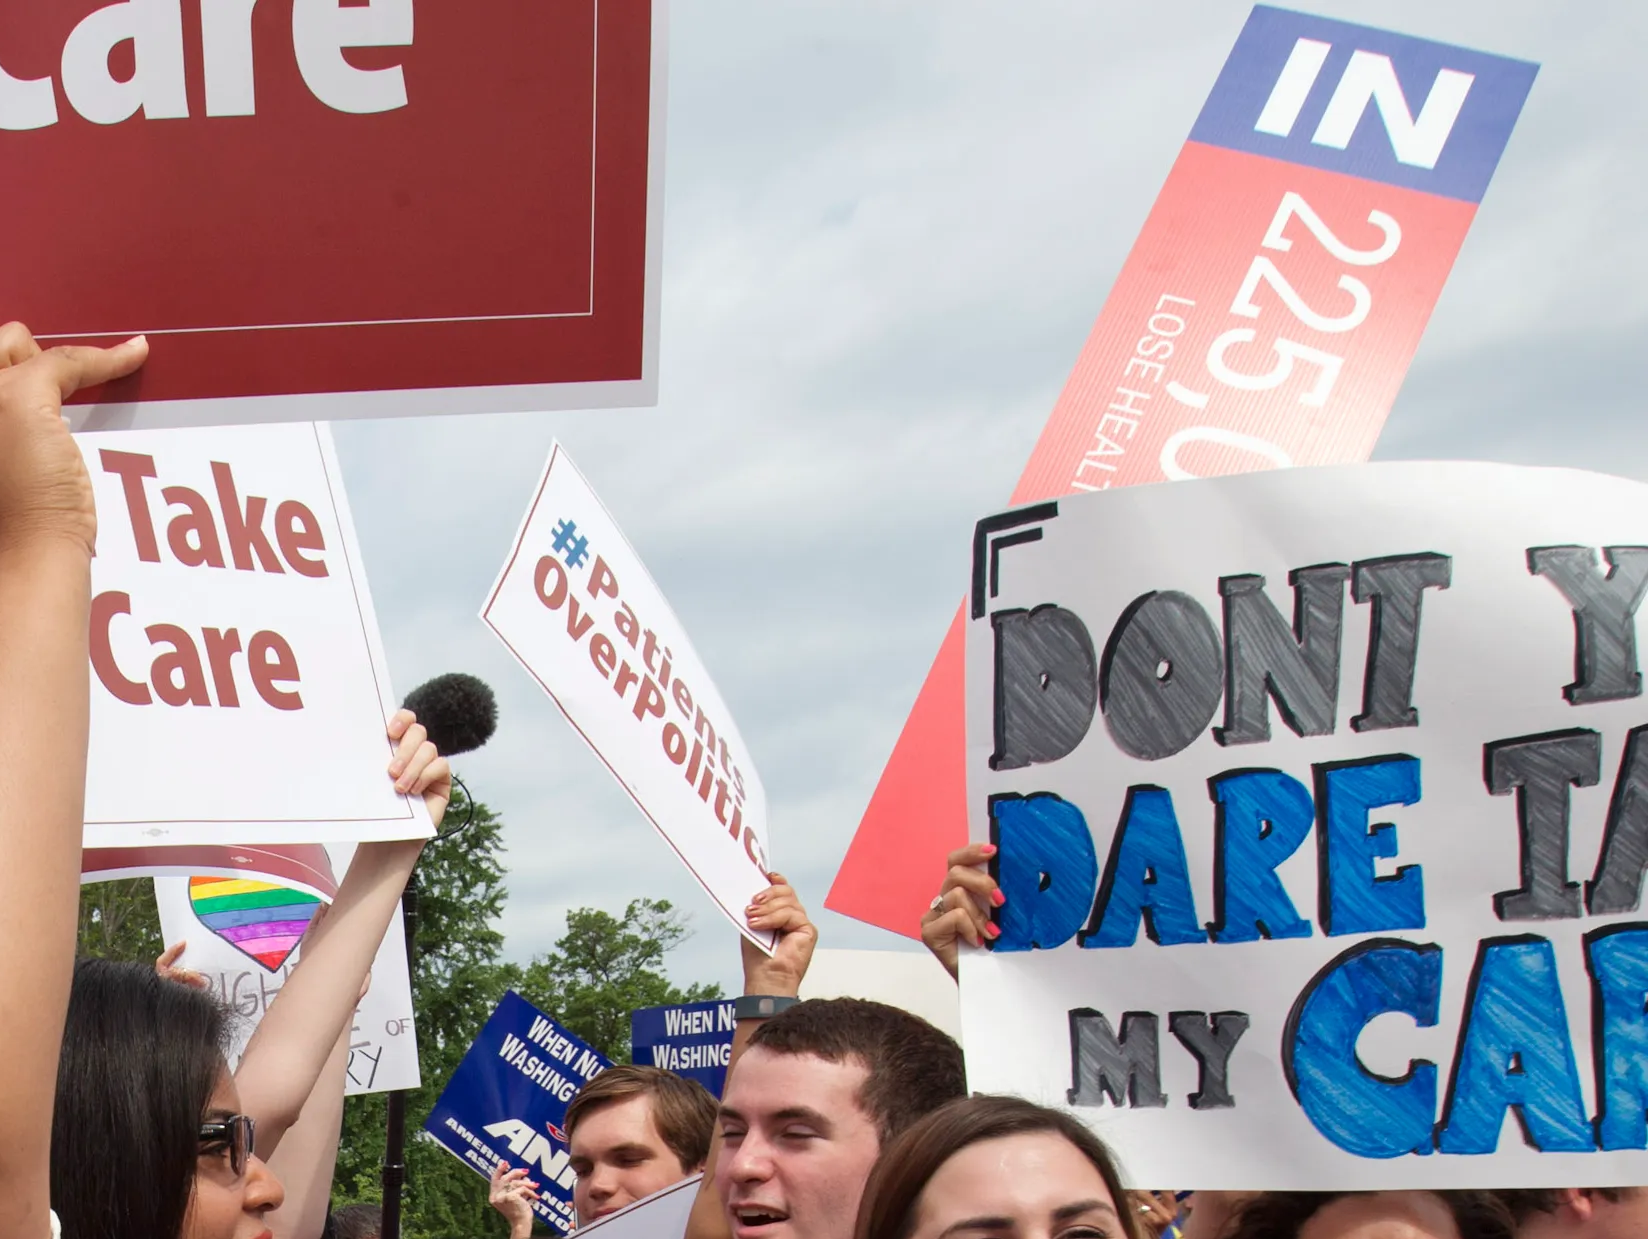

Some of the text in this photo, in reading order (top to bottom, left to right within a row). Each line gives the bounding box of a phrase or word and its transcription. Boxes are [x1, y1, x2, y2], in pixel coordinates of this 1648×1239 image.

[1253, 36, 1476, 171] IN
[1123, 293, 1196, 383] LOSE
[98, 447, 330, 578] Take
[89, 590, 305, 711] Care
[550, 518, 747, 803] #Patients
[988, 551, 1452, 771] DONT
[987, 752, 1426, 952] DARE
[385, 1017, 411, 1037] OF
[499, 1032, 581, 1103] WASHING
[527, 1014, 580, 1066] WHEN
[665, 1008, 714, 1037] WHEN
[1067, 1006, 1251, 1109] MY
